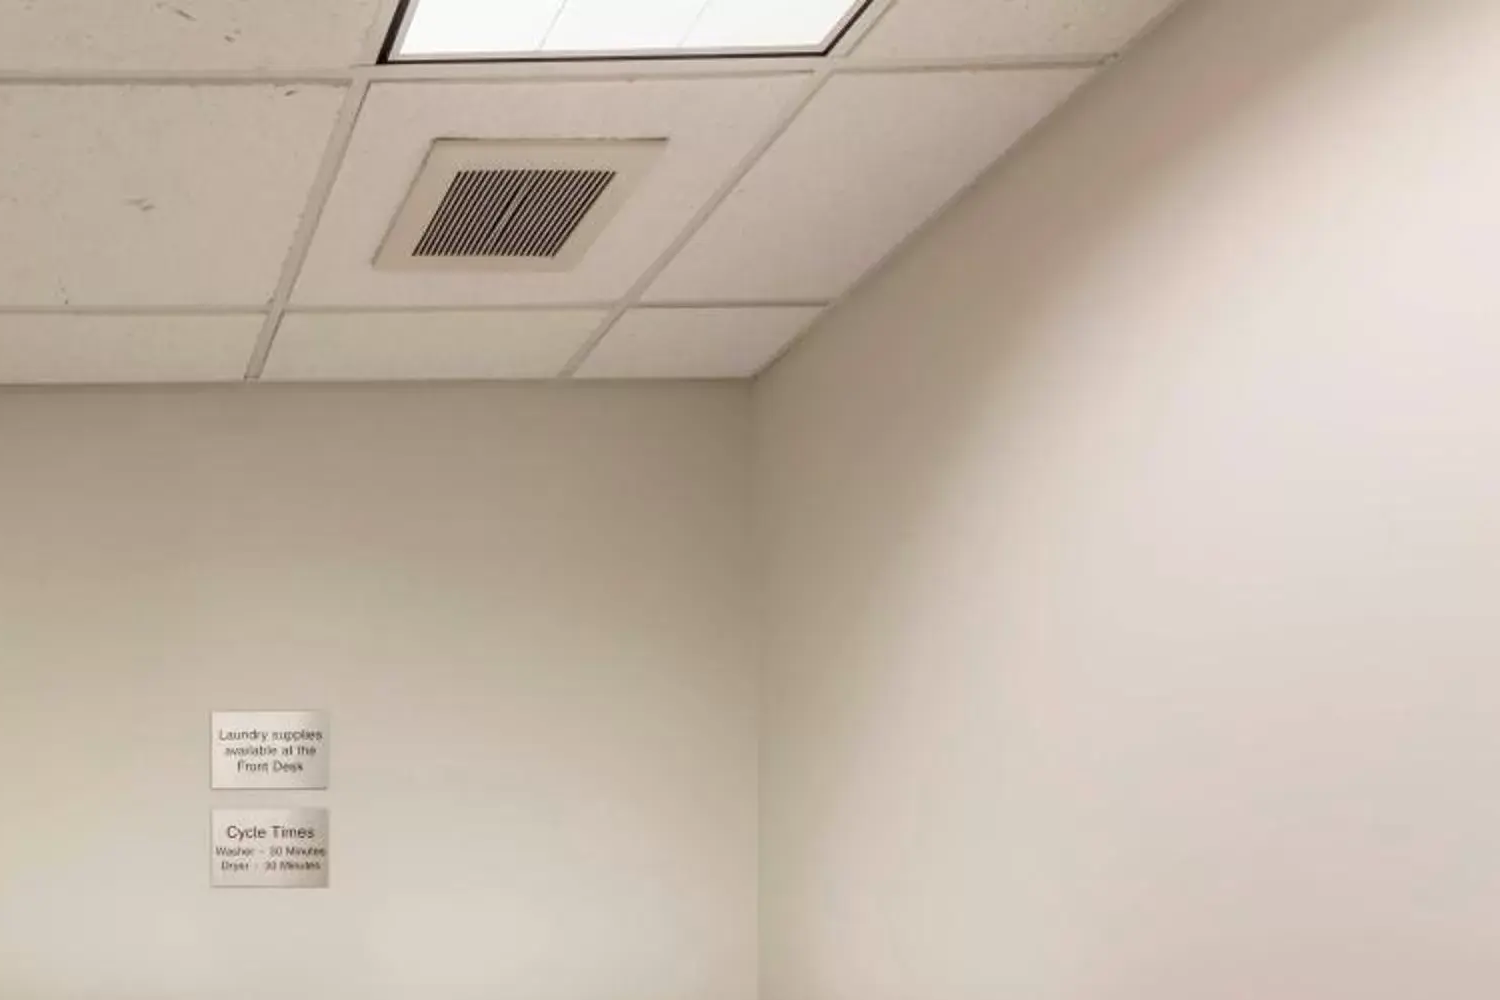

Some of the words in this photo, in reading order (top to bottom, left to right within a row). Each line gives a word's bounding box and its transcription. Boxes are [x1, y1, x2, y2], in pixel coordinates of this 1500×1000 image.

[219, 728, 269, 743] Laundry
[272, 728, 323, 743] supplies
[224, 745, 278, 756] available
[281, 745, 294, 756] at
[297, 745, 317, 757] the
[237, 760, 269, 773] Front
[273, 760, 304, 773] Desk
[227, 825, 267, 842] Cycle
[270, 825, 316, 840] Times
[215, 846, 254, 857] Washer
[285, 846, 327, 858] Minutes
[221, 861, 250, 873] Dryer
[280, 861, 321, 872] Minutes
